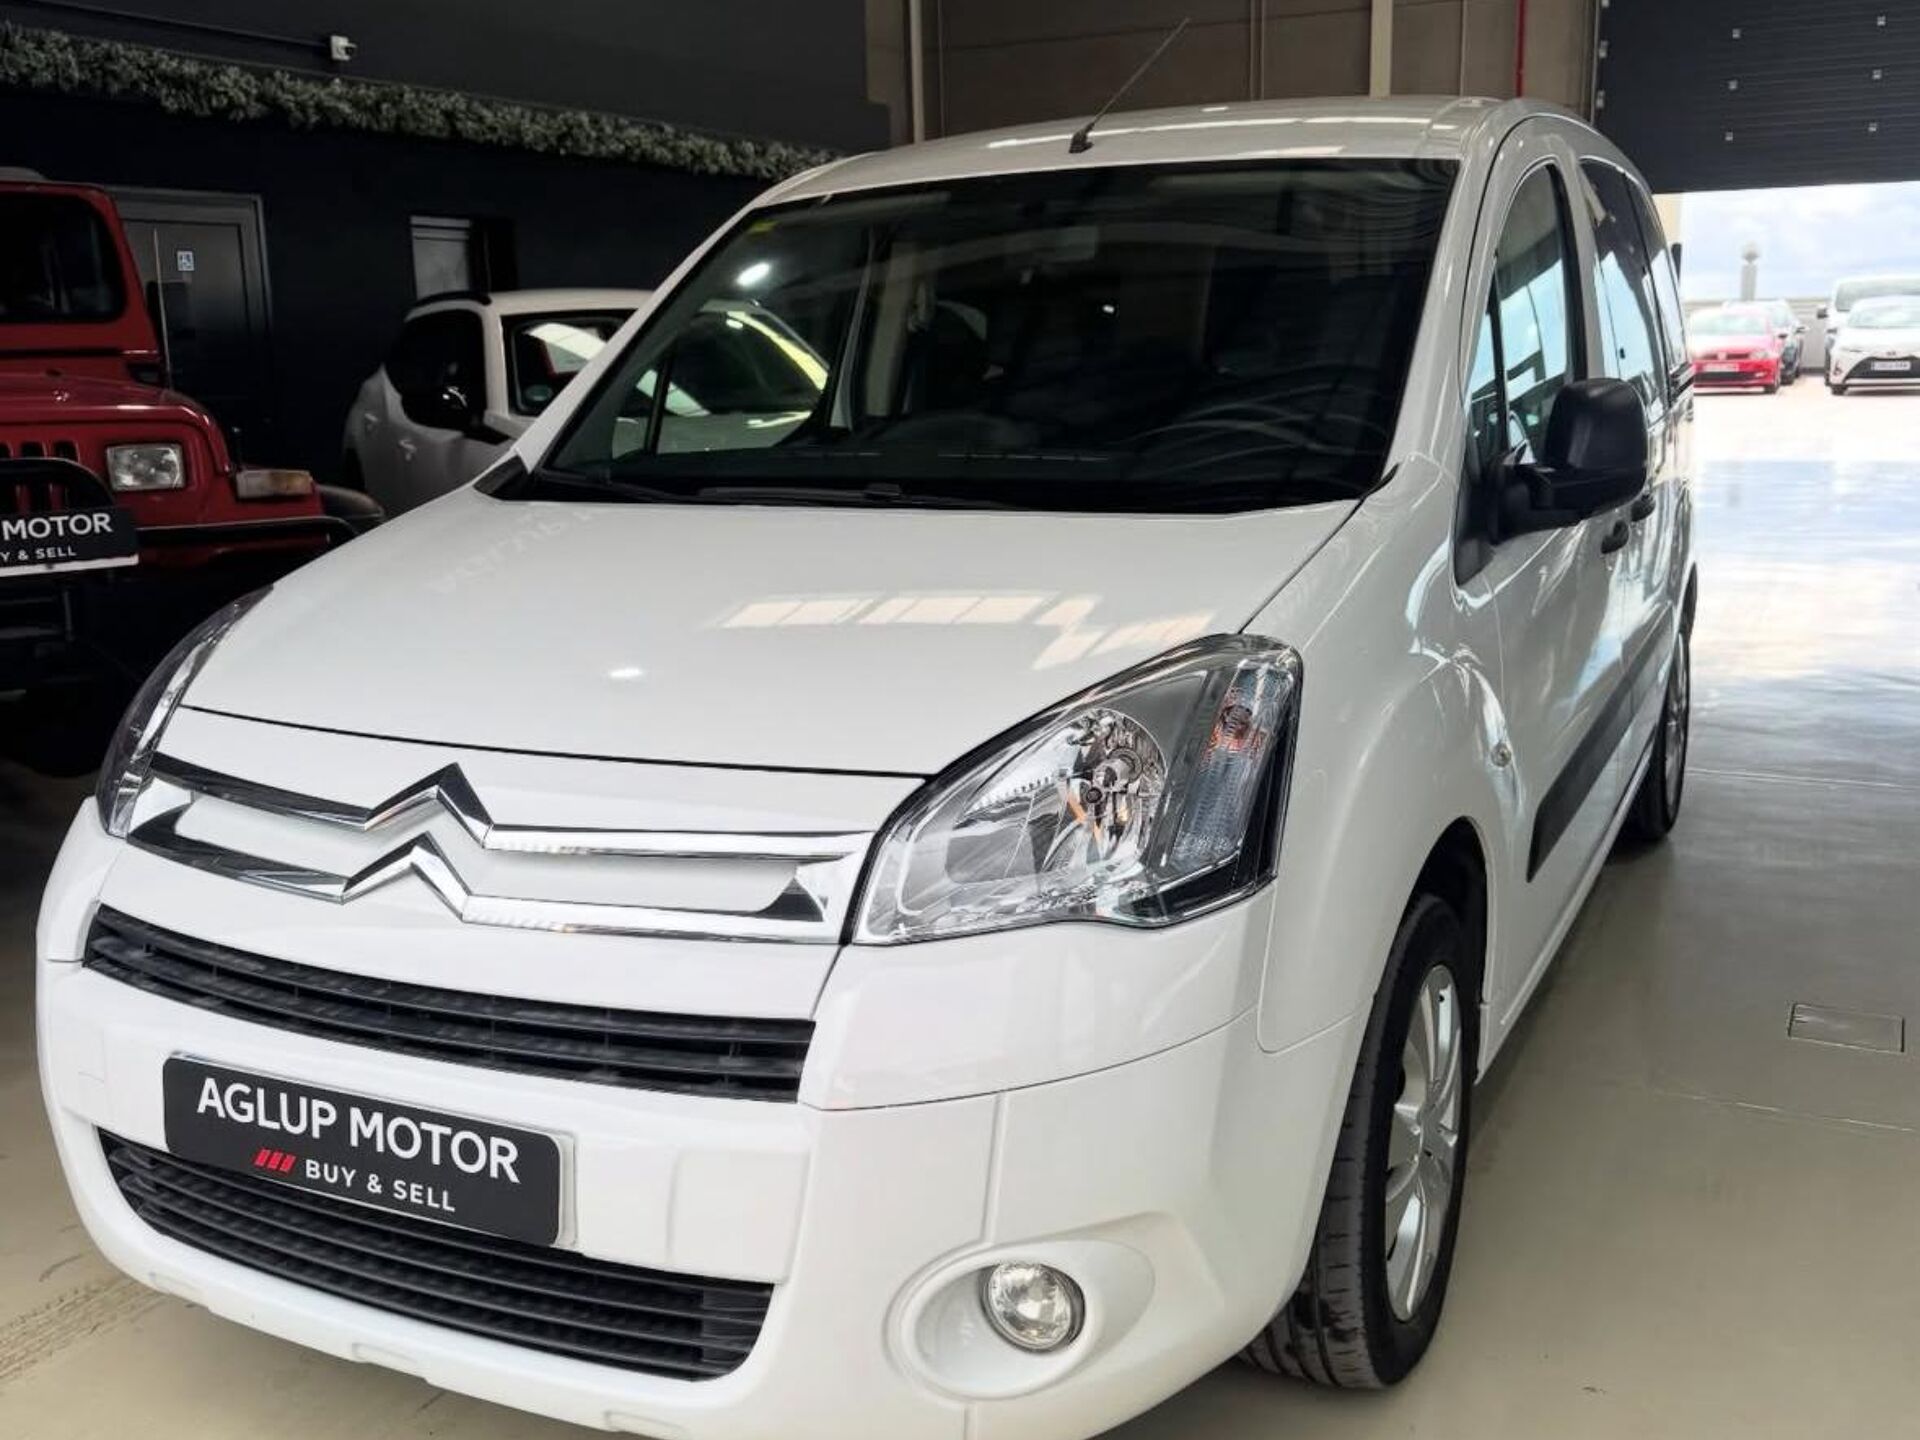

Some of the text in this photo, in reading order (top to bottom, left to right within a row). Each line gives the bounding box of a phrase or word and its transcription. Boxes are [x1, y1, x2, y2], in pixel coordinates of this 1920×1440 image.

[2, 512, 113, 541] MOTOR
[18, 549, 29, 560] &
[35, 545, 77, 560] SELL
[197, 1077, 520, 1184] AGLUP MOTOR
[305, 1159, 456, 1212] BUY & SELL
